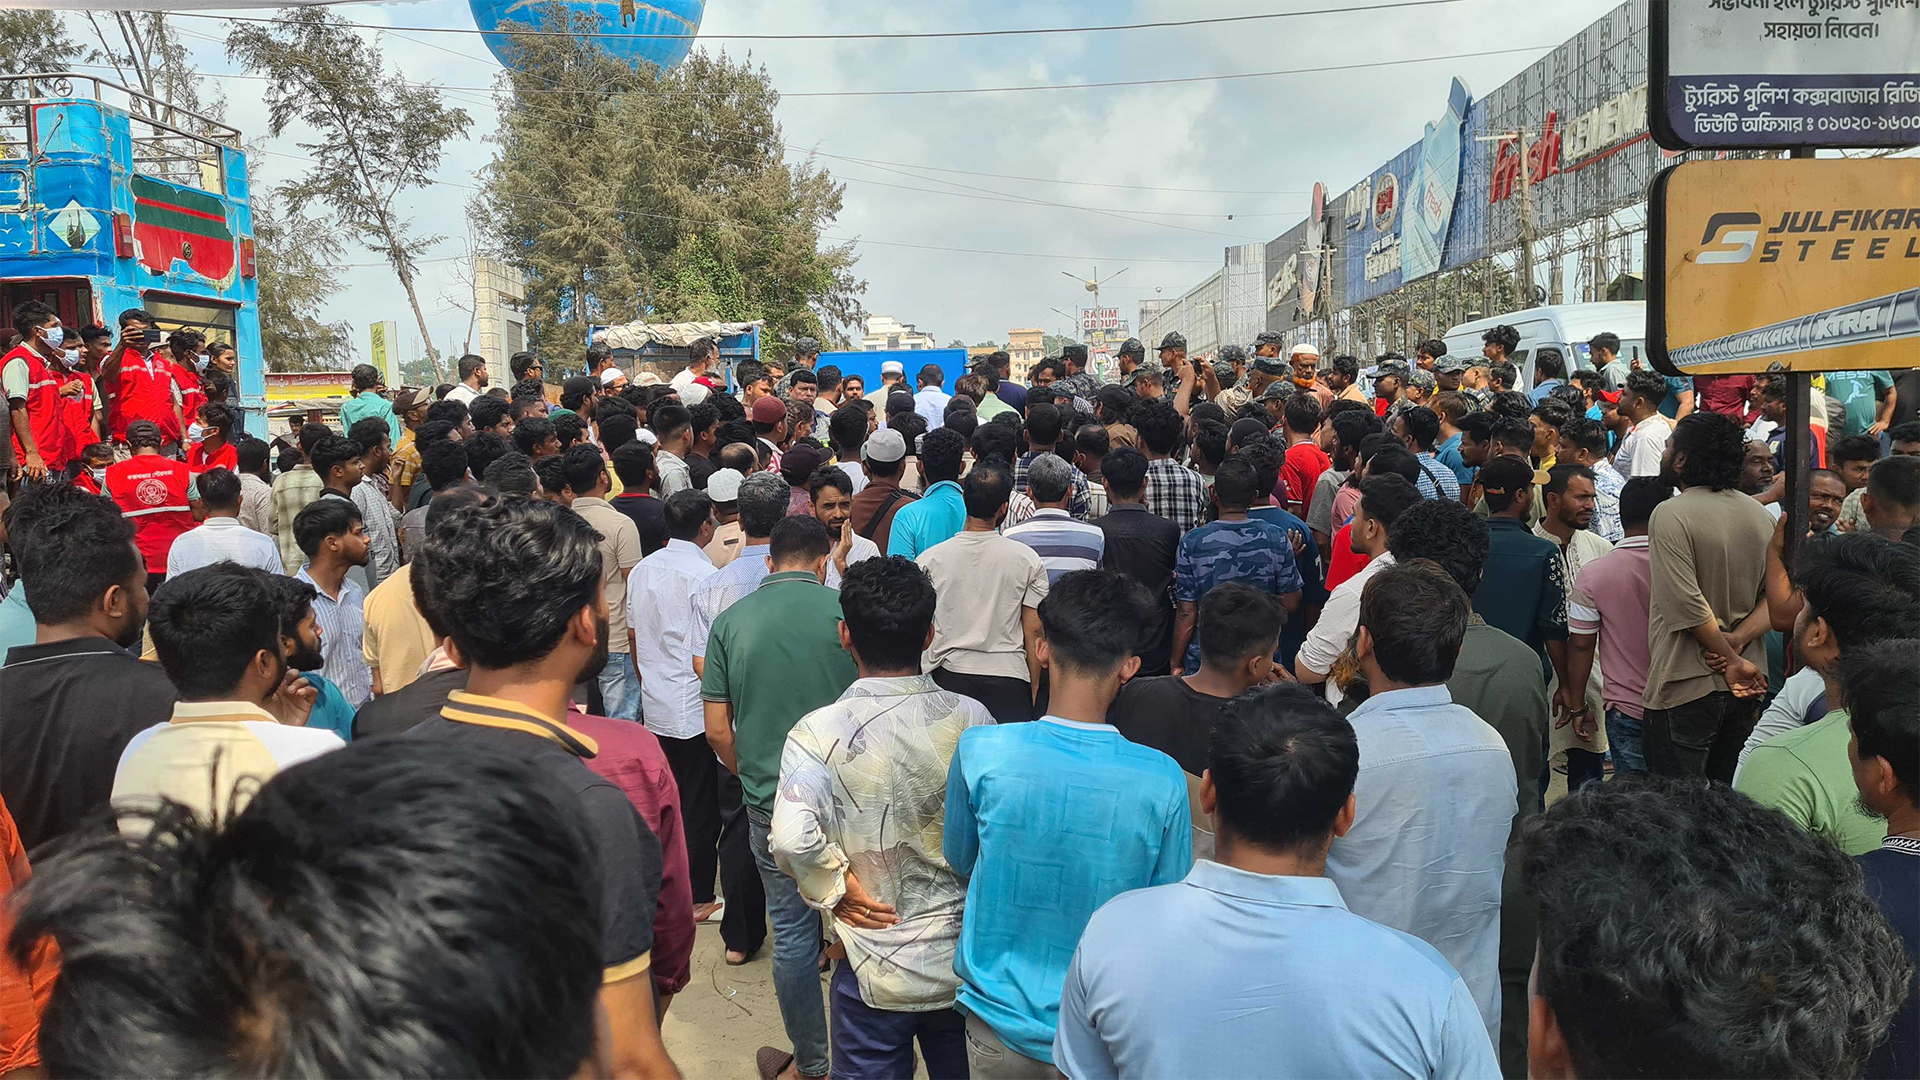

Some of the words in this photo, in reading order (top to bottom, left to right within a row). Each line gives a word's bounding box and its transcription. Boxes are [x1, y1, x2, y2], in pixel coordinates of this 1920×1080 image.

[1763, 22, 1822, 41] সহায়তা
[1825, 16, 1879, 39] নিবেন।
[1684, 82, 1740, 113] ট্যুরিস্ট
[1743, 82, 1790, 112] পুলিশ
[1792, 87, 1880, 107] কক্সবাজার
[1694, 113, 1739, 134] ডিউটি
[1741, 112, 1804, 133] অফিসার
[1490, 110, 1561, 203] Frsh
[1767, 208, 1920, 234] JULFIKAR
[1759, 237, 1920, 263] STEEL
[1814, 305, 1882, 340] XTRA
[1825, 370, 1871, 381] MESSI
